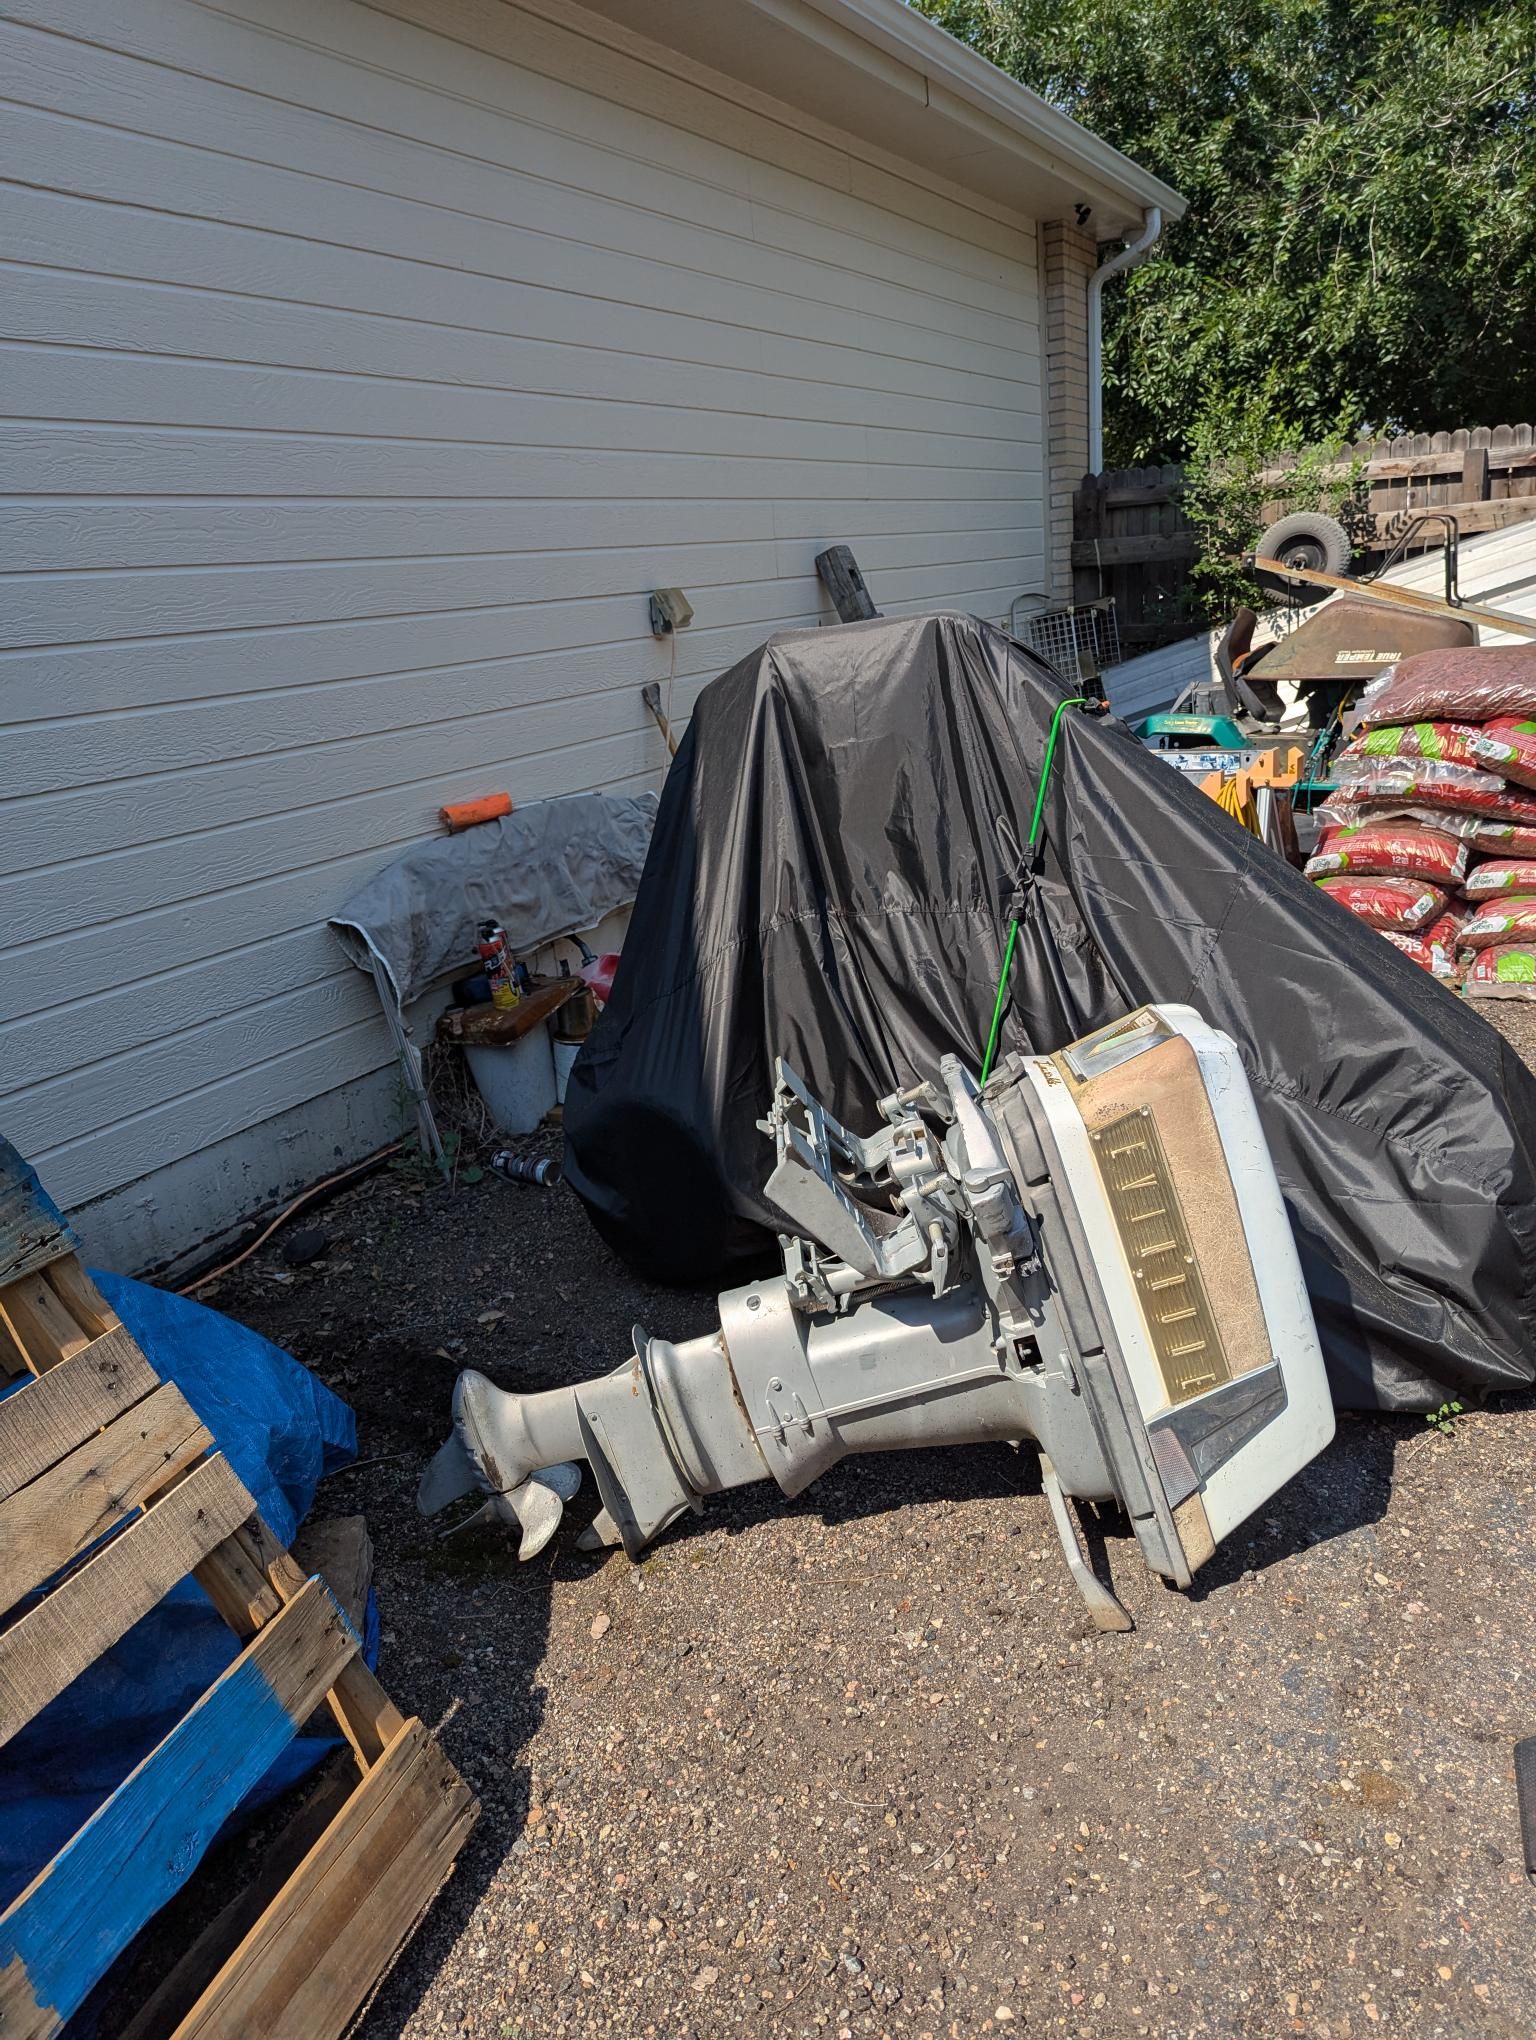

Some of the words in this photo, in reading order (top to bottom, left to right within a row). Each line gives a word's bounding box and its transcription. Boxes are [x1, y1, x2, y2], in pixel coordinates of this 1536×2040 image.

[1335, 653, 1375, 663] TEMPER
[1376, 652, 1402, 662] TRUE
[1392, 855, 1401, 864] 12
[1415, 858, 1422, 866] 2
[1110, 1141, 1217, 1391] EVINRUDE
